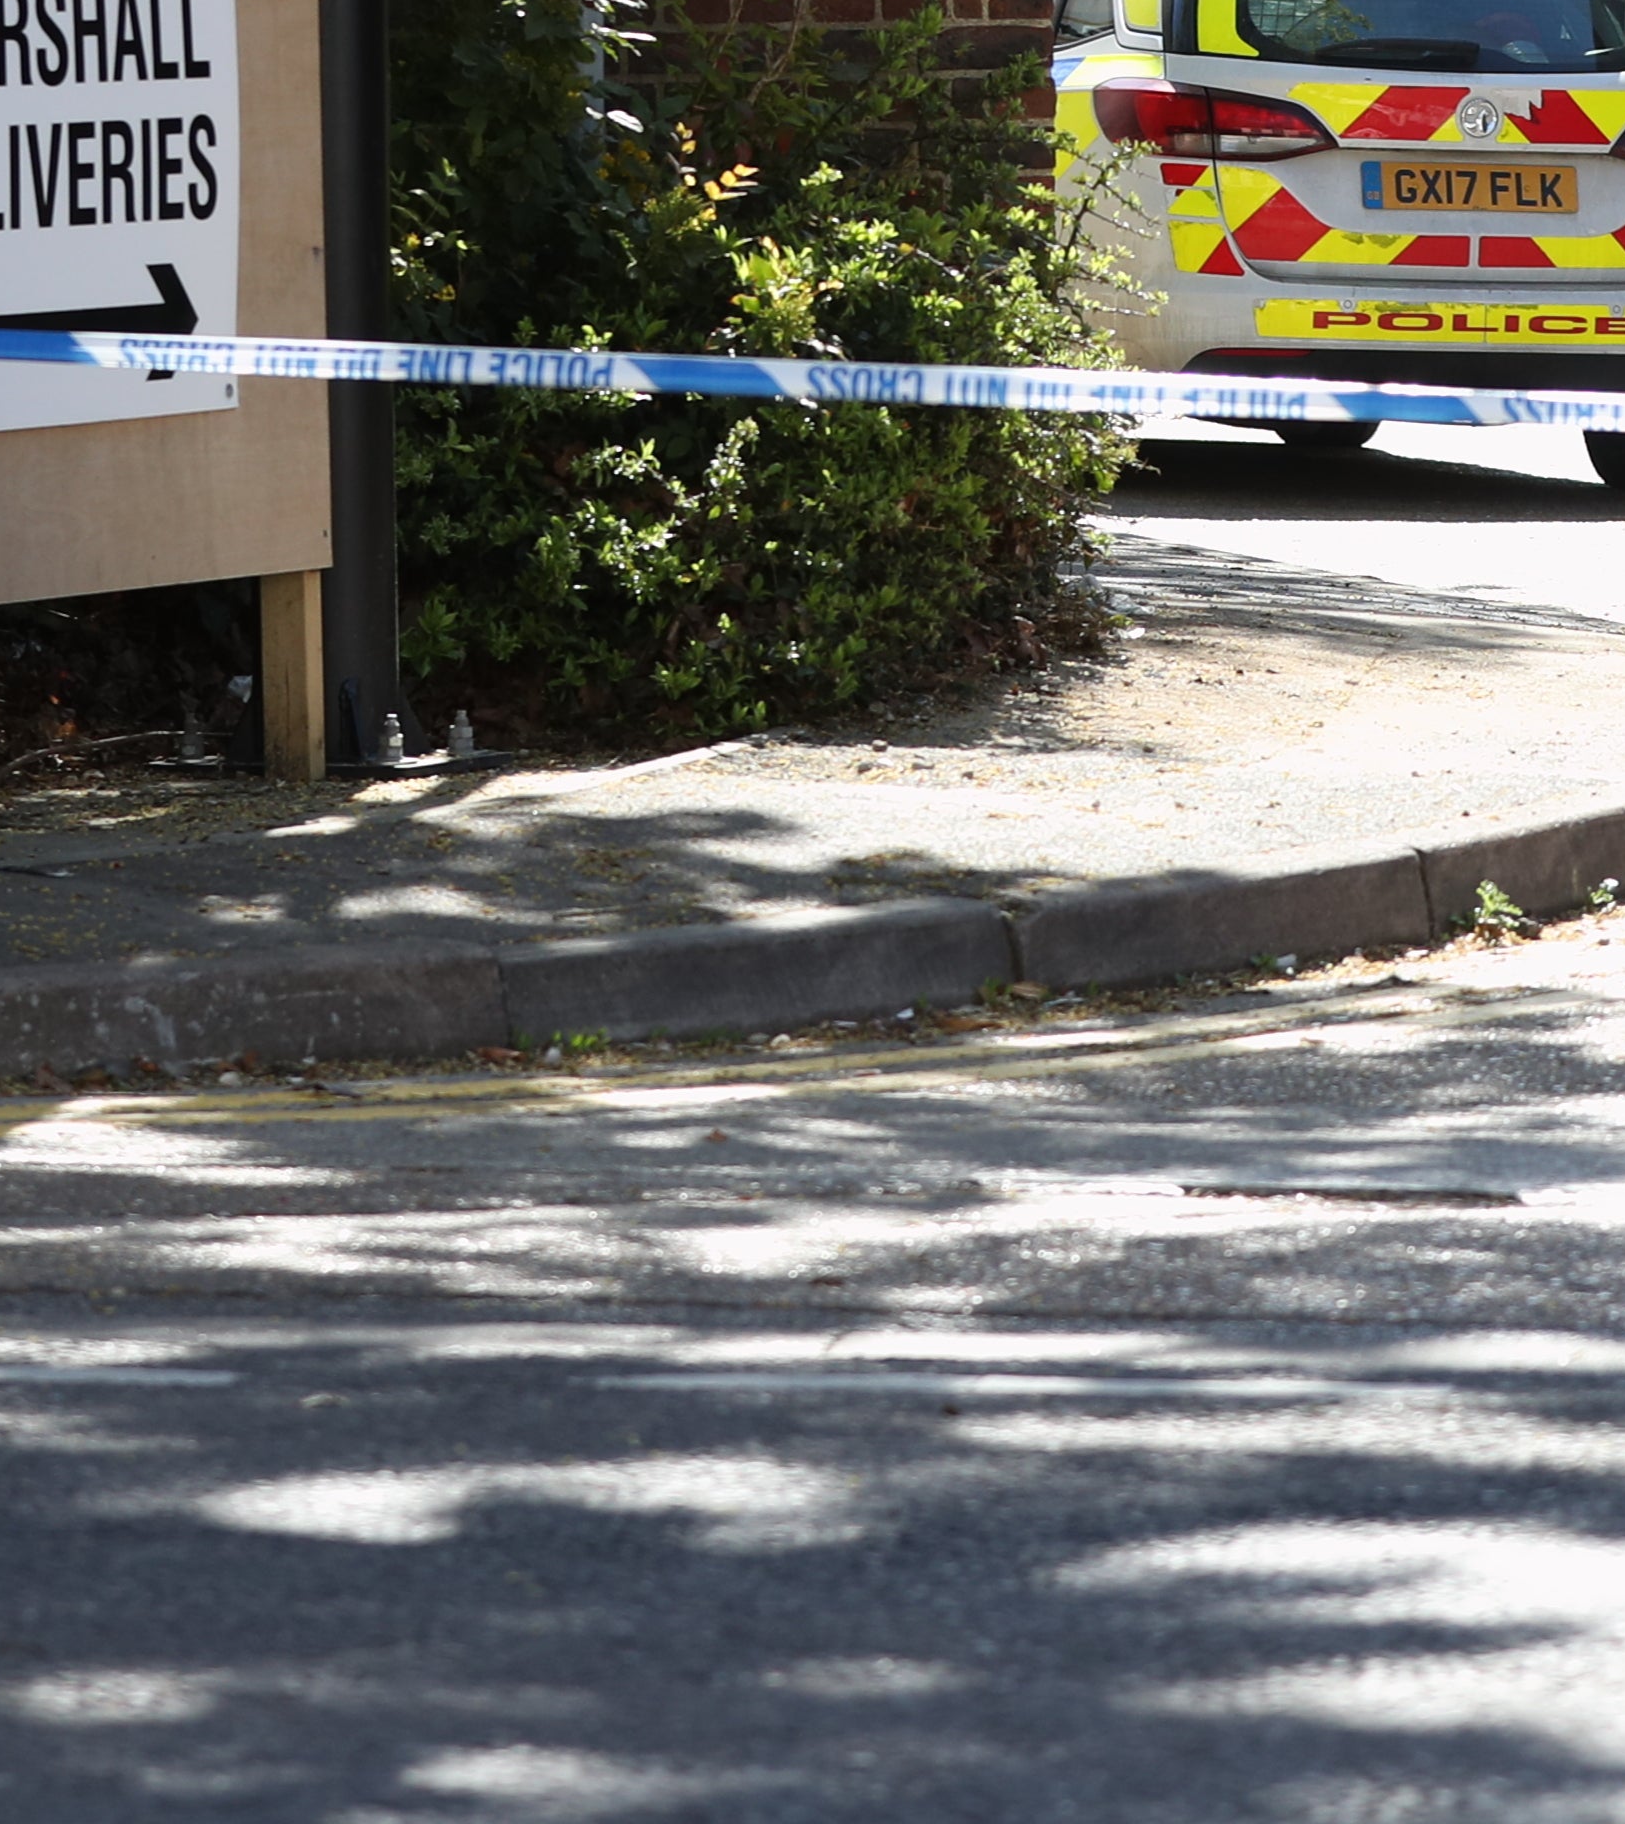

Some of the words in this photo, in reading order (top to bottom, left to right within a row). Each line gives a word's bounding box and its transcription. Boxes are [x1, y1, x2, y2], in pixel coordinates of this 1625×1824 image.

[1394, 168, 1478, 205] GX17
[1489, 170, 1564, 208] FLK
[397, 349, 472, 383] LINE
[489, 353, 614, 388] POLICE
[806, 366, 924, 403] CROSS
